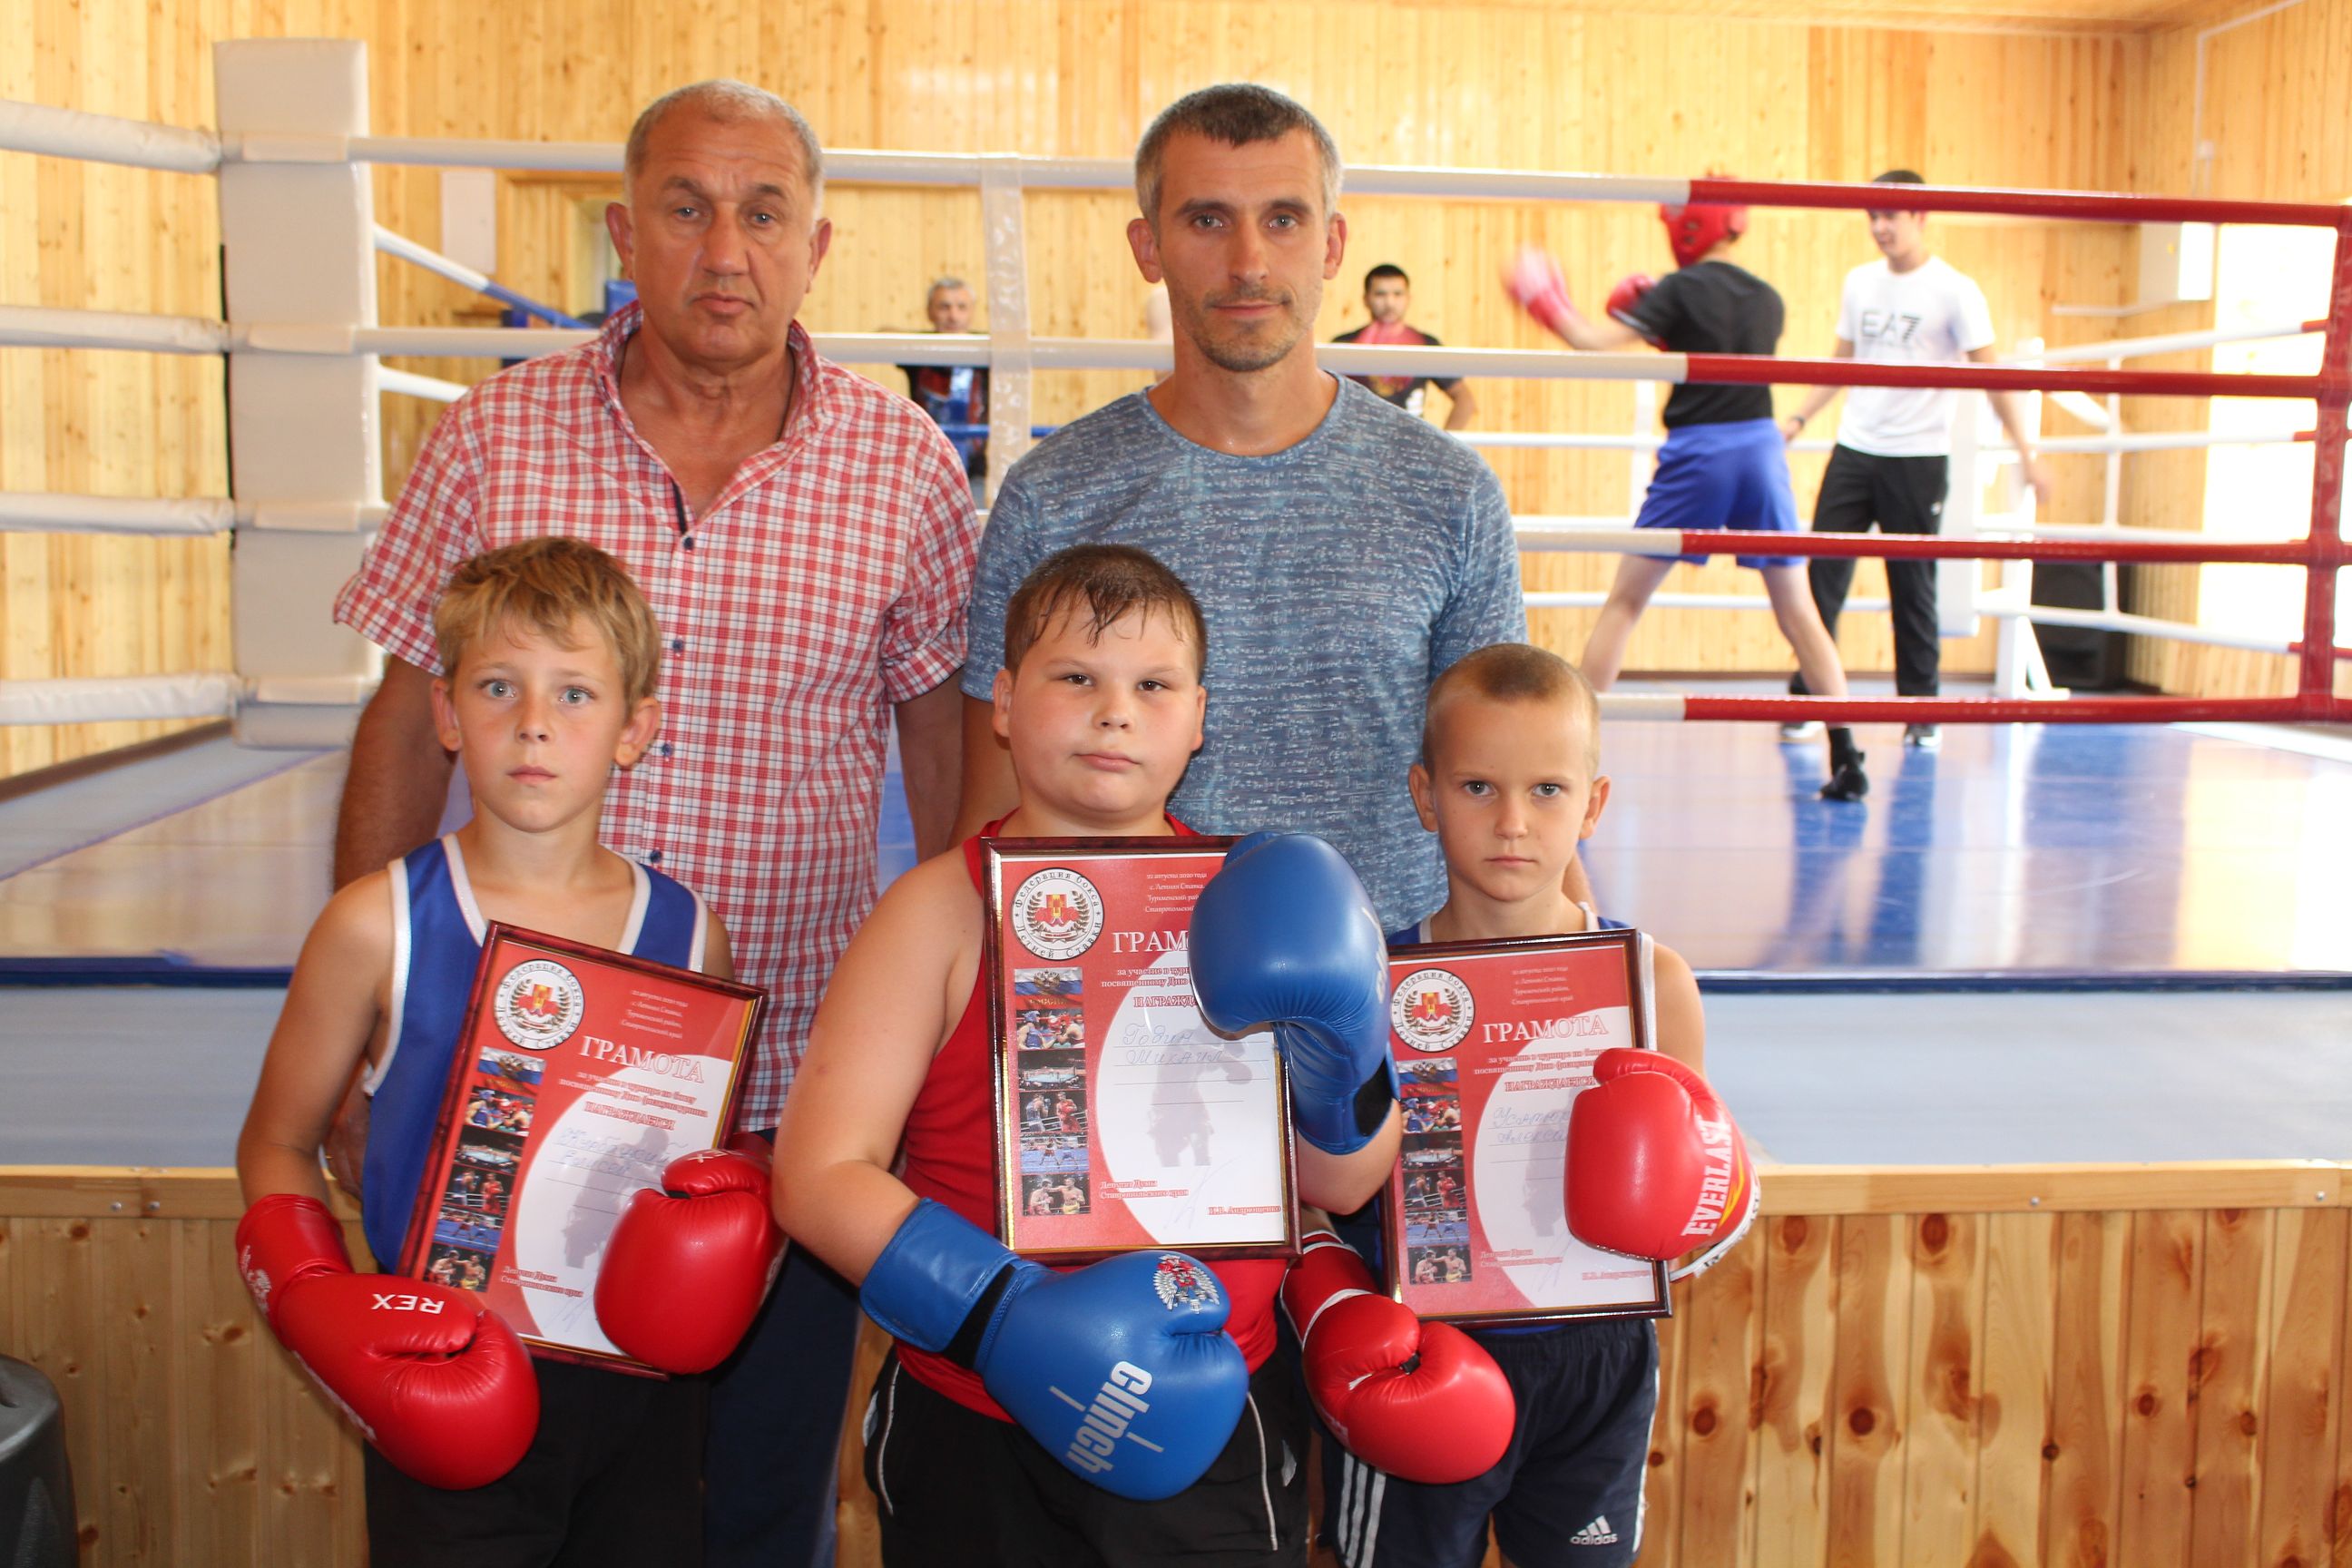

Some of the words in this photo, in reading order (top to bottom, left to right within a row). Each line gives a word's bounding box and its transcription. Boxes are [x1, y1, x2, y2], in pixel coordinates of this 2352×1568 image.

[1860, 309, 1921, 344] EA7
[1015, 872, 1072, 908] Федерация
[1076, 876, 1100, 906] бокса
[1016, 925, 1054, 958] Летней
[1065, 922, 1102, 958] Ставки
[1112, 930, 1188, 954] ГРАМ
[1128, 968, 1161, 977] участие
[1170, 967, 1190, 975] турн
[1133, 995, 1197, 1007] НАГРАЖД
[1483, 1014, 1610, 1044] ГРАМОТА
[579, 1035, 705, 1083] ГРАМОТА
[1681, 1112, 1734, 1238] EVERLAST
[371, 1293, 446, 1315] REX
[1570, 1534, 1618, 1545] adidas
